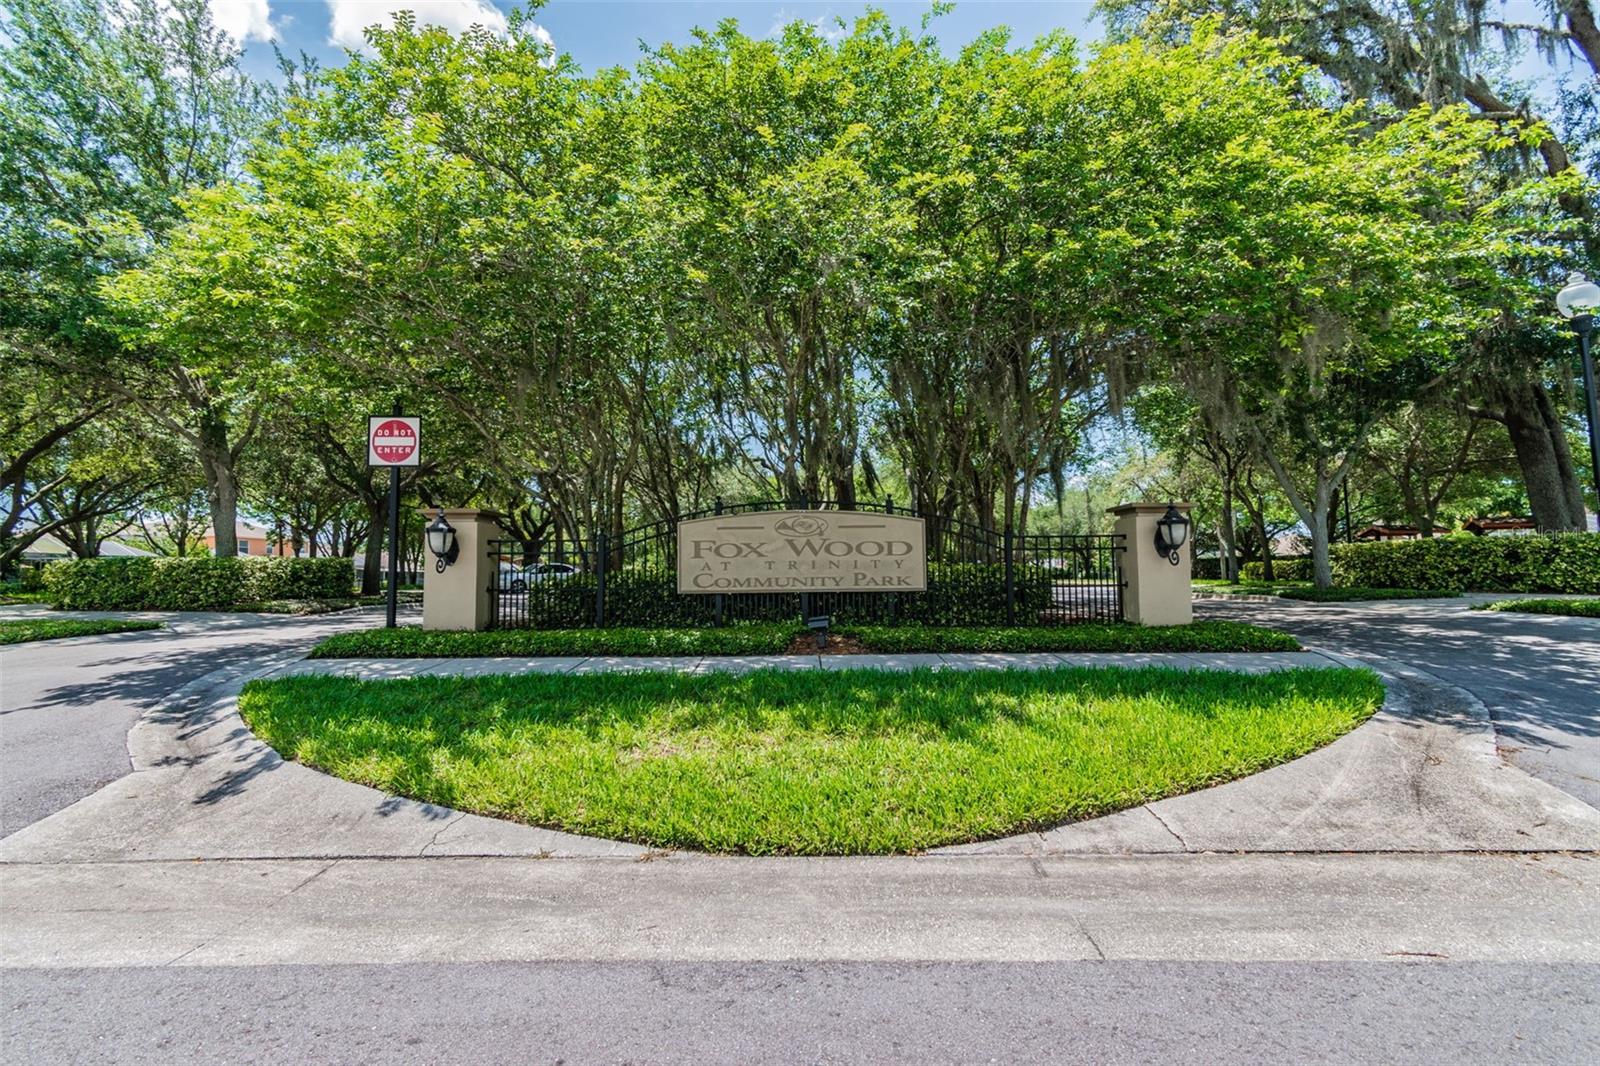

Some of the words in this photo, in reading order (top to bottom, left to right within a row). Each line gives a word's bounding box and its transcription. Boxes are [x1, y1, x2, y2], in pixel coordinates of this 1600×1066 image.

[377, 446, 411, 454] ENTER
[690, 540, 768, 559] FOX
[784, 538, 913, 558] WOOD
[701, 561, 731, 571] AT
[765, 559, 905, 570] TRINITY
[693, 573, 844, 589] COMMUNITY
[853, 572, 912, 587] PARK
